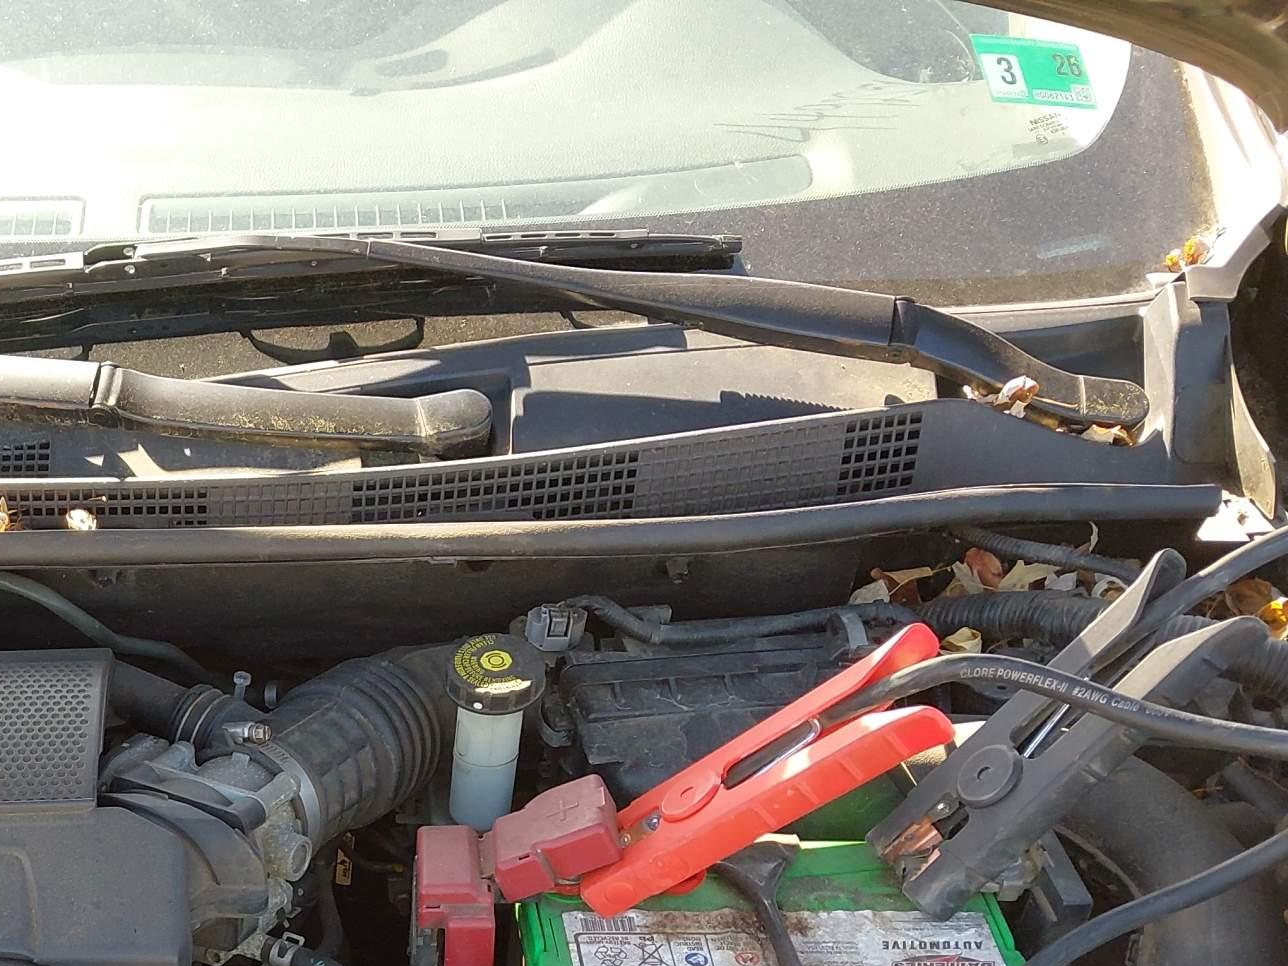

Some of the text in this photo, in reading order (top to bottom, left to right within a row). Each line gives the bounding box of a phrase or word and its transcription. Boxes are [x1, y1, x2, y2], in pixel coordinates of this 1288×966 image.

[996, 56, 1017, 85] 3
[1052, 53, 1082, 78] 26
[959, 667, 996, 679] CLORE
[1071, 685, 1108, 704] #2AWG
[881, 940, 984, 950] AUTOMOTIVE
